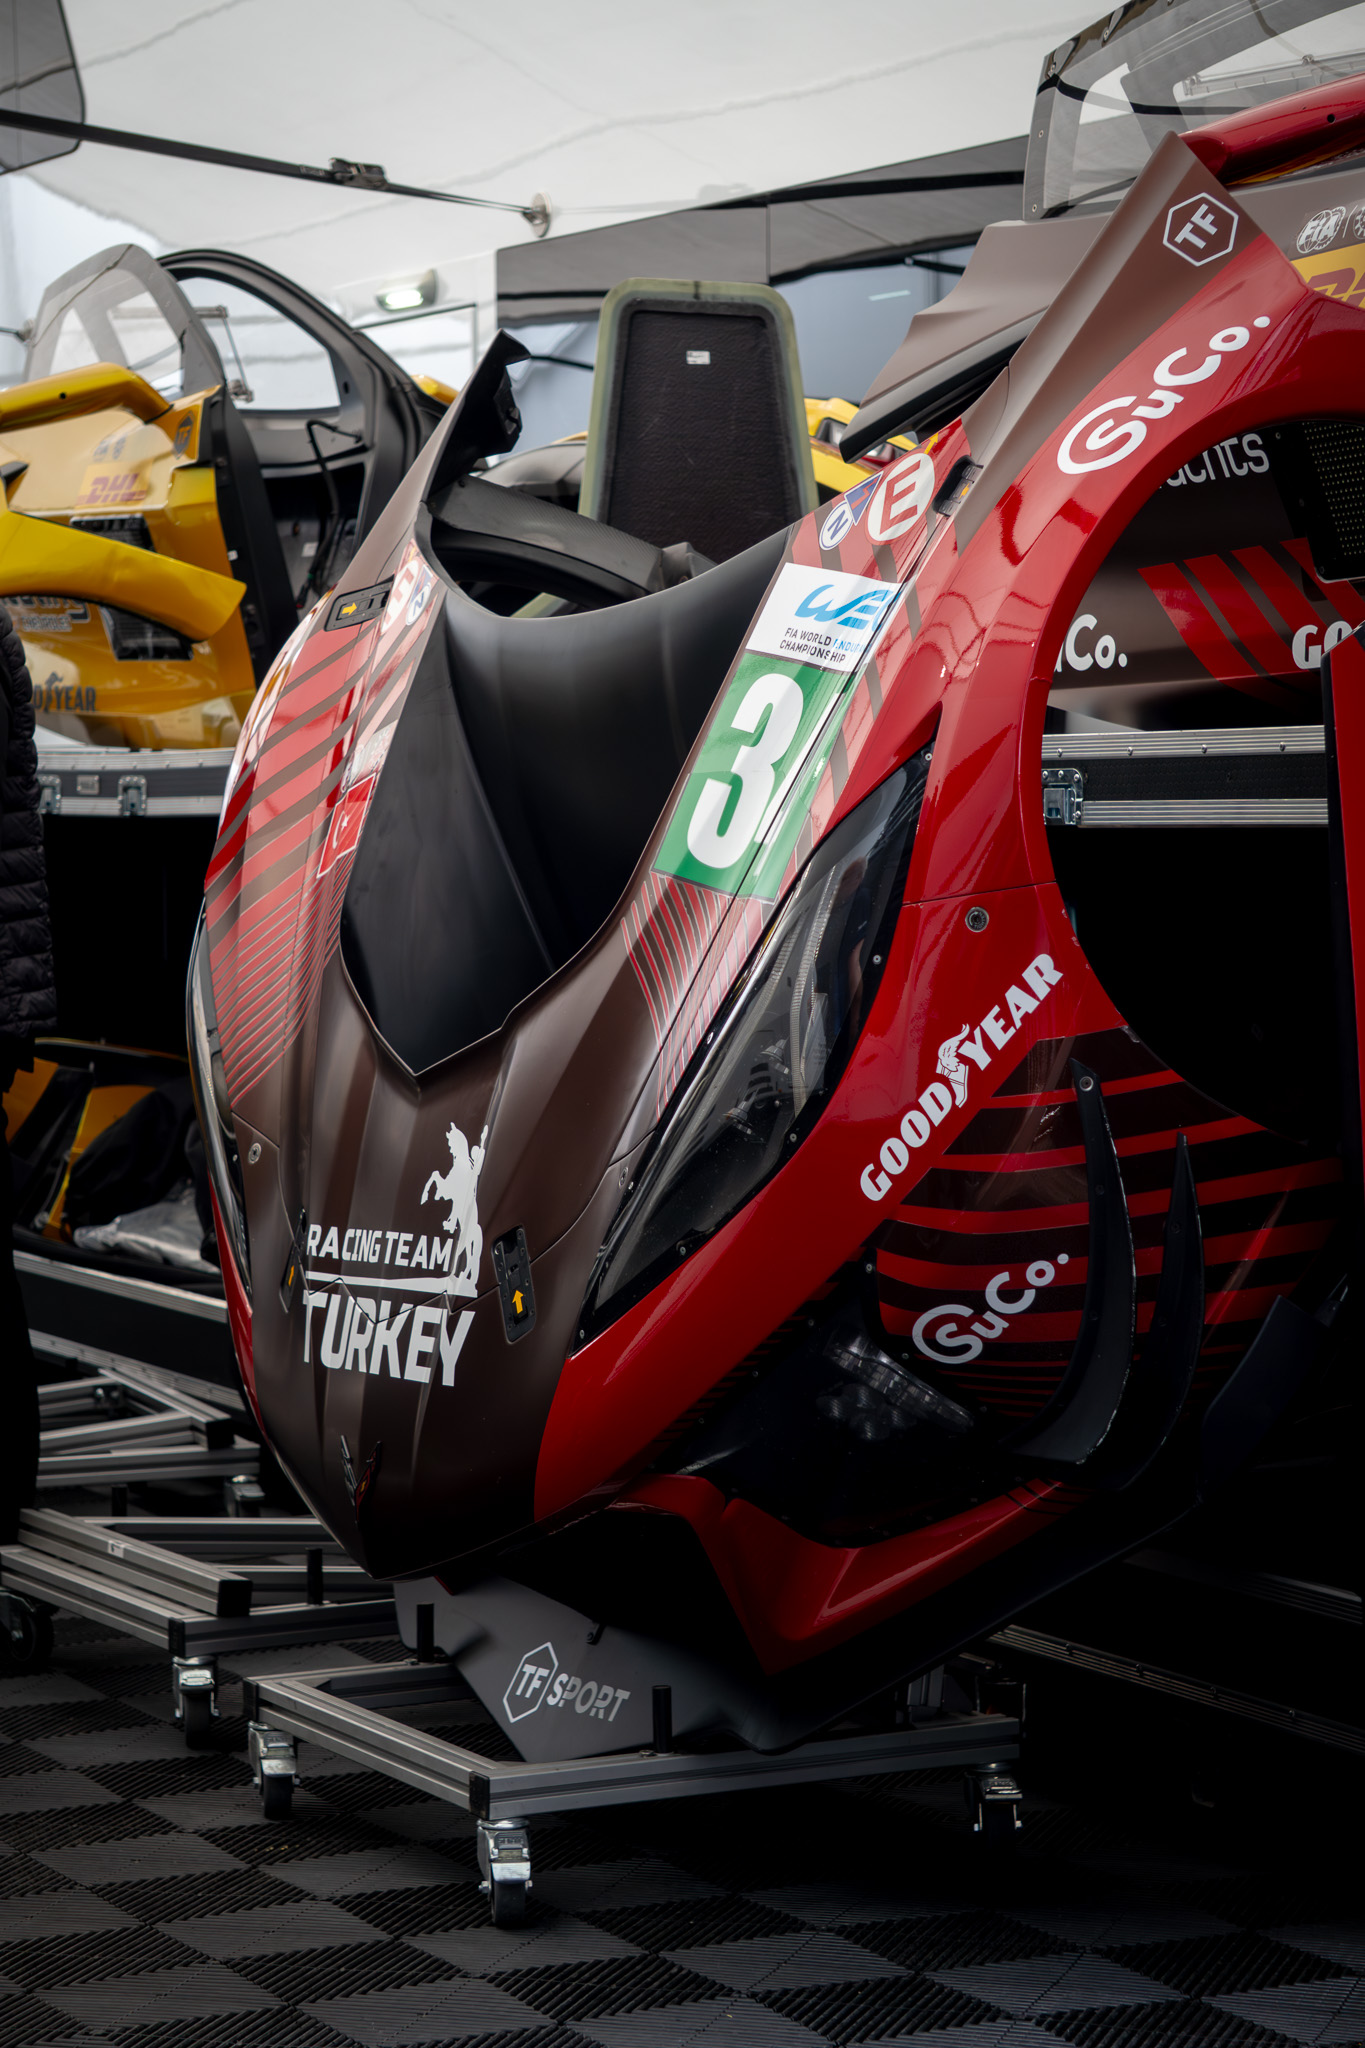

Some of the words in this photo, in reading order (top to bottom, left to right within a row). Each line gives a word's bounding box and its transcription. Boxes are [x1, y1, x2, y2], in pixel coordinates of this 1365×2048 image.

[1175, 204, 1218, 249] TF
[85, 473, 138, 504] DHL
[880, 460, 922, 535] E
[780, 639, 846, 663] CHAMPIONSHIP
[785, 627, 798, 639] FIA
[800, 630, 832, 646] WORLD
[1054, 613, 1128, 673] Co.
[306, 1224, 382, 1263] RACING
[384, 1232, 454, 1272] TEAM
[303, 1290, 476, 1387] TURKEY
[515, 1664, 550, 1698] TF
[546, 1673, 631, 1722] SPORT
